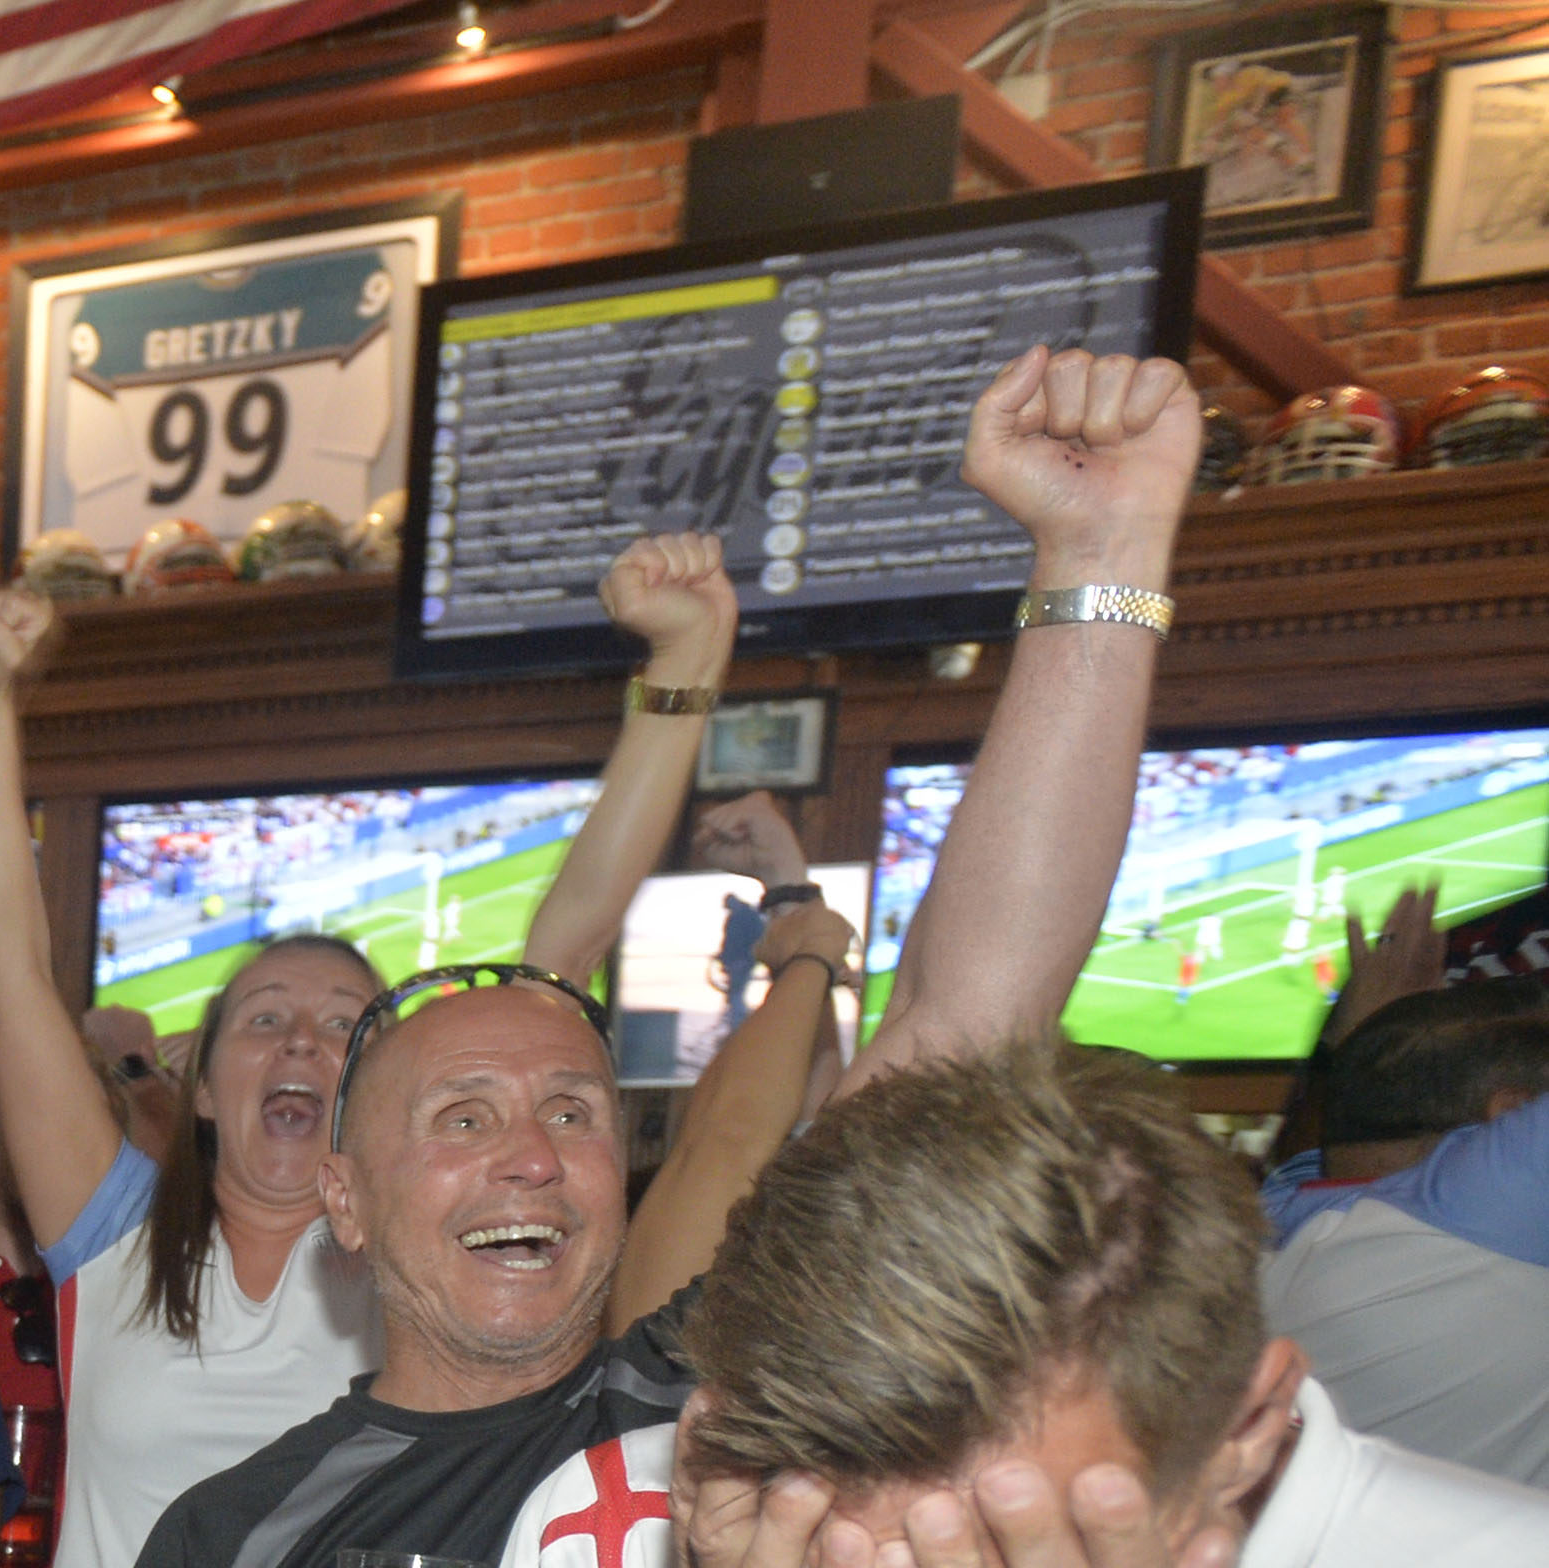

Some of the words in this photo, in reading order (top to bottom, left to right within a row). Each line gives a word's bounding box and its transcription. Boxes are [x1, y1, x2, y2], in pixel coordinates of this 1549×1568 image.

[356, 270, 394, 318] 9
[145, 307, 302, 369] GRETZKY
[146, 377, 289, 506] 99
